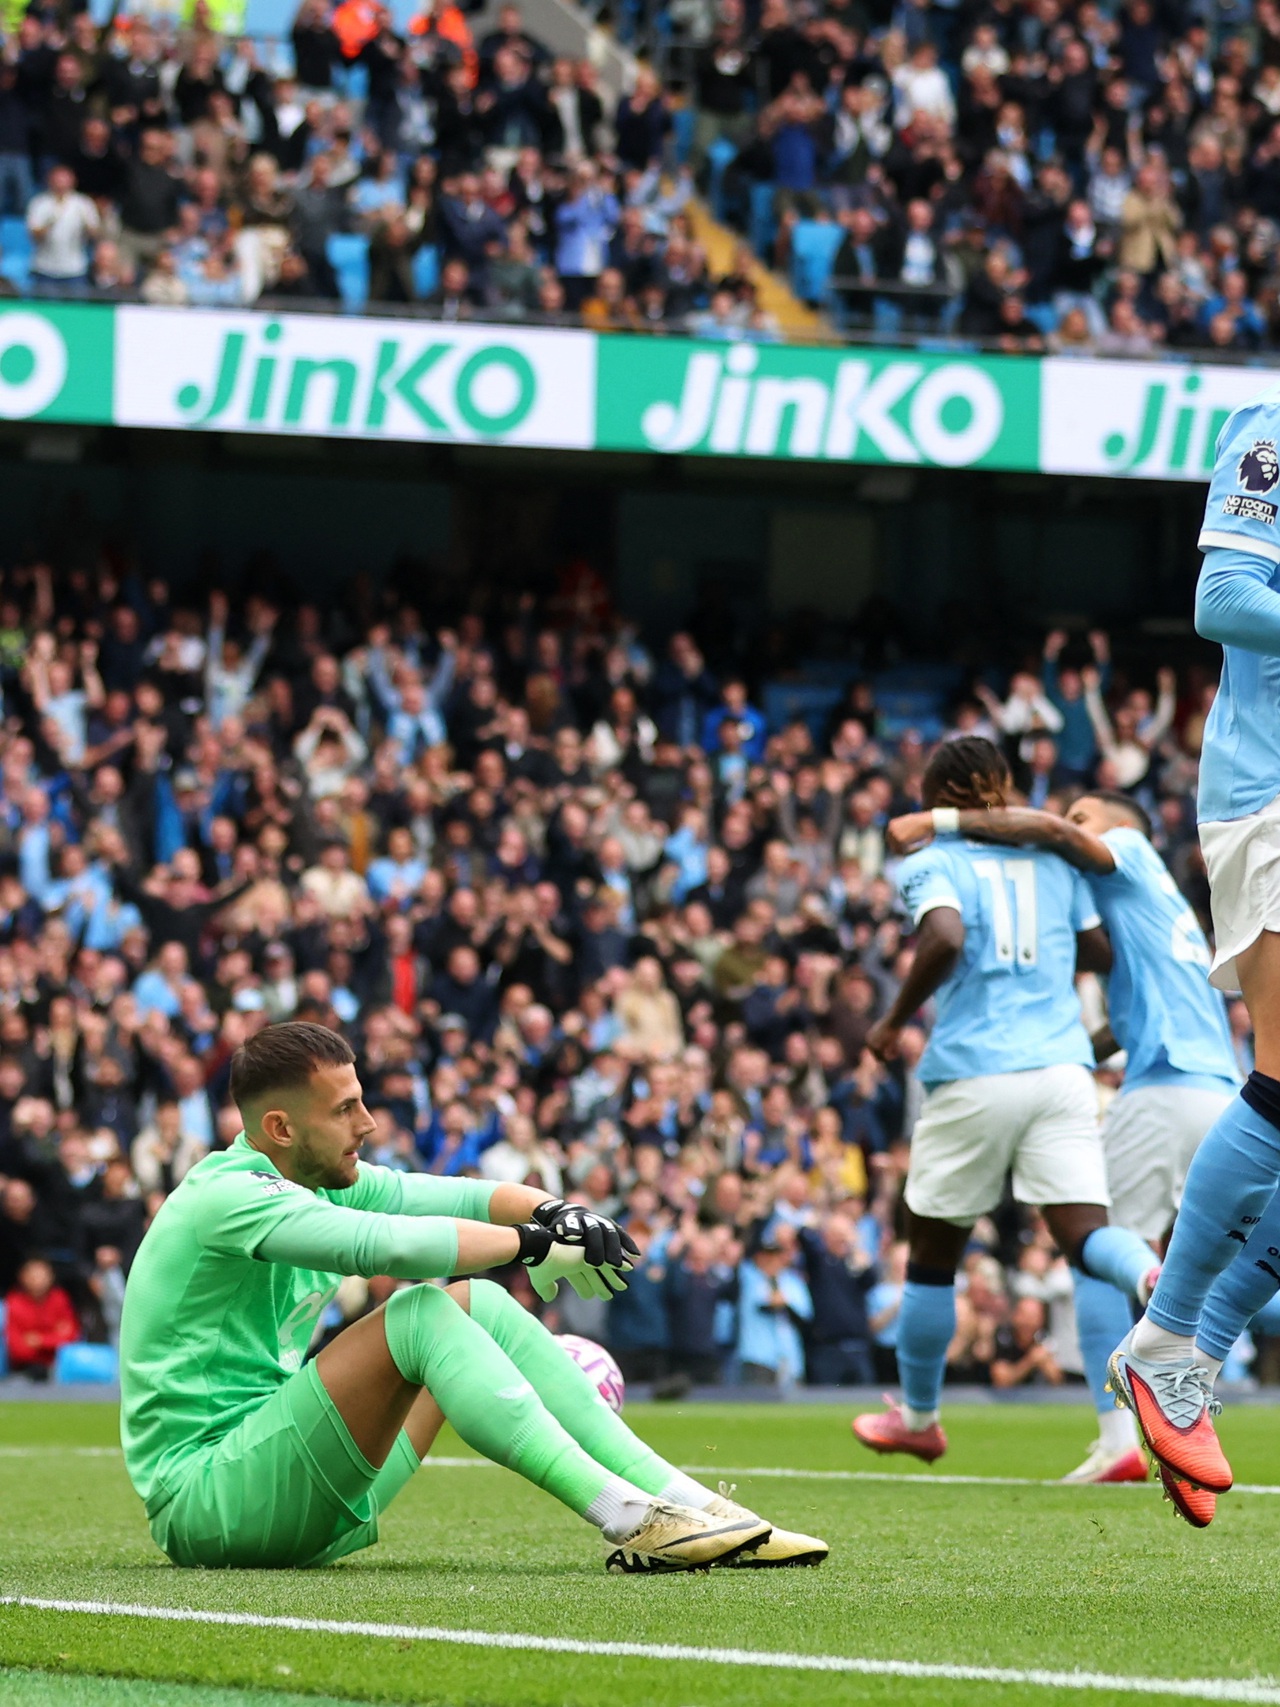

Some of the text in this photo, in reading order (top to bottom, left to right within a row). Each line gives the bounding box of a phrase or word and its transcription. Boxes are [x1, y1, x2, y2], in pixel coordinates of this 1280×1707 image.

[1222, 504, 1275, 526] for racism
[1225, 495, 1273, 515] No room
[970, 859, 1038, 966] 11
